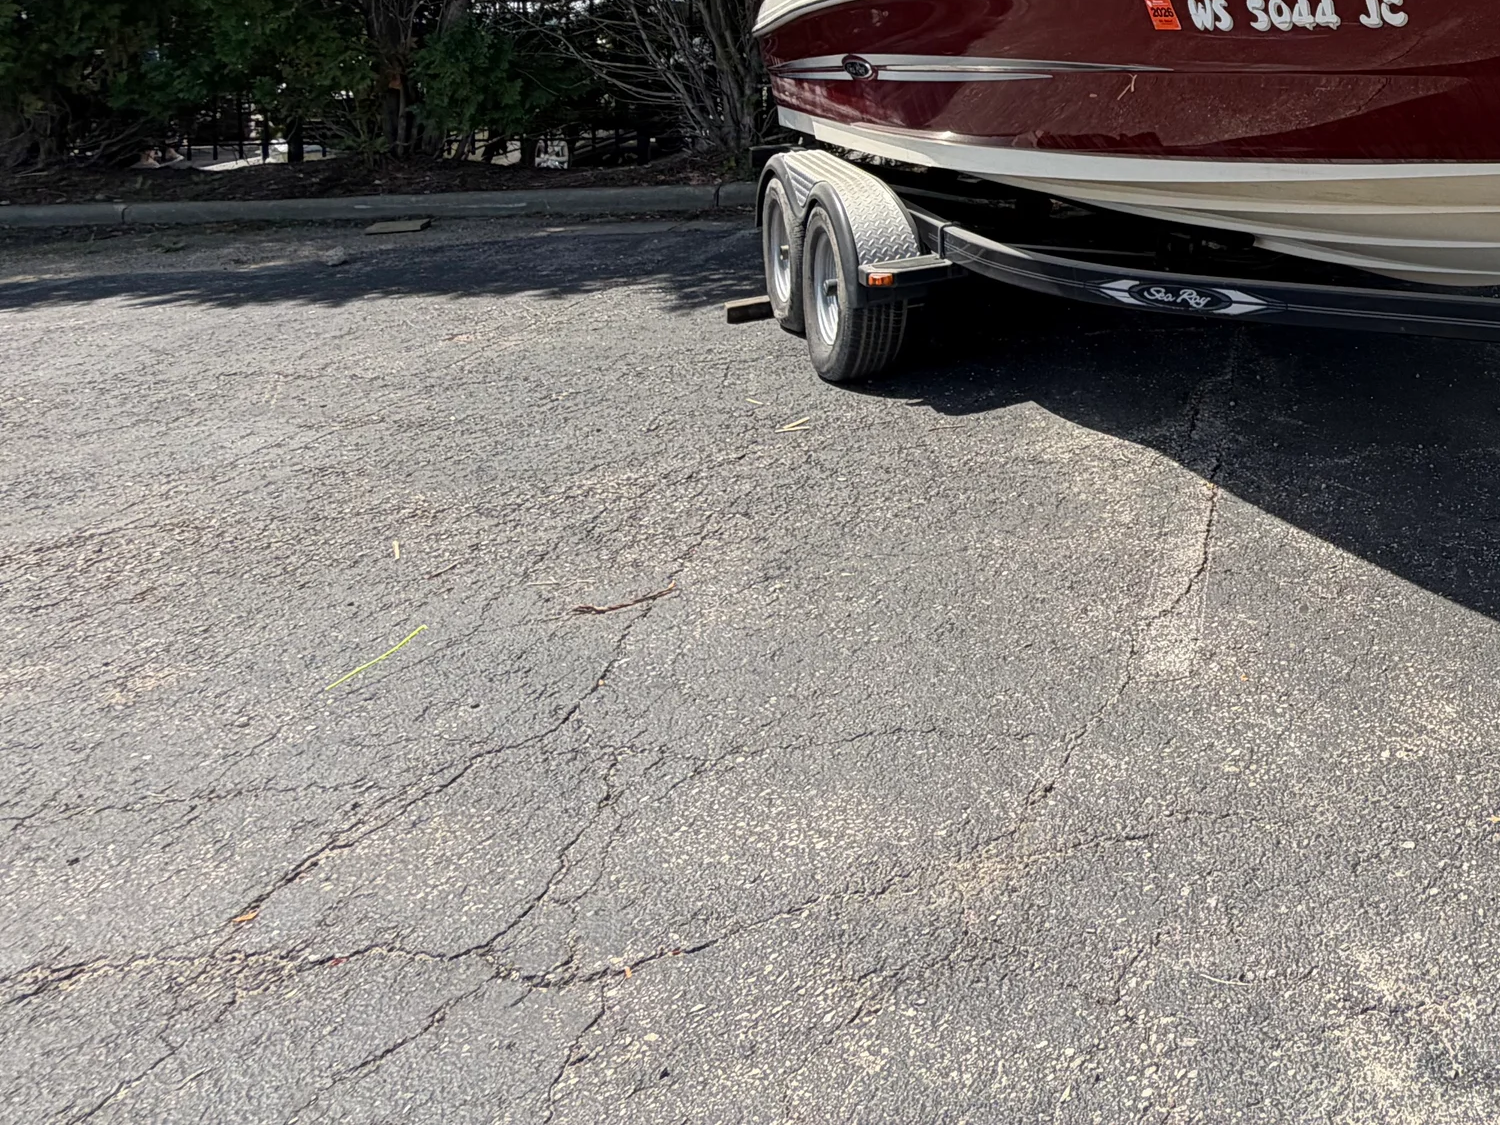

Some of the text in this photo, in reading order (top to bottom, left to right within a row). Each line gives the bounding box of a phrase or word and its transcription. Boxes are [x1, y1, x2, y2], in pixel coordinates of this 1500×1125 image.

[1151, 7, 1174, 17] 2026
[1144, 287, 1211, 308] Sea Ray
